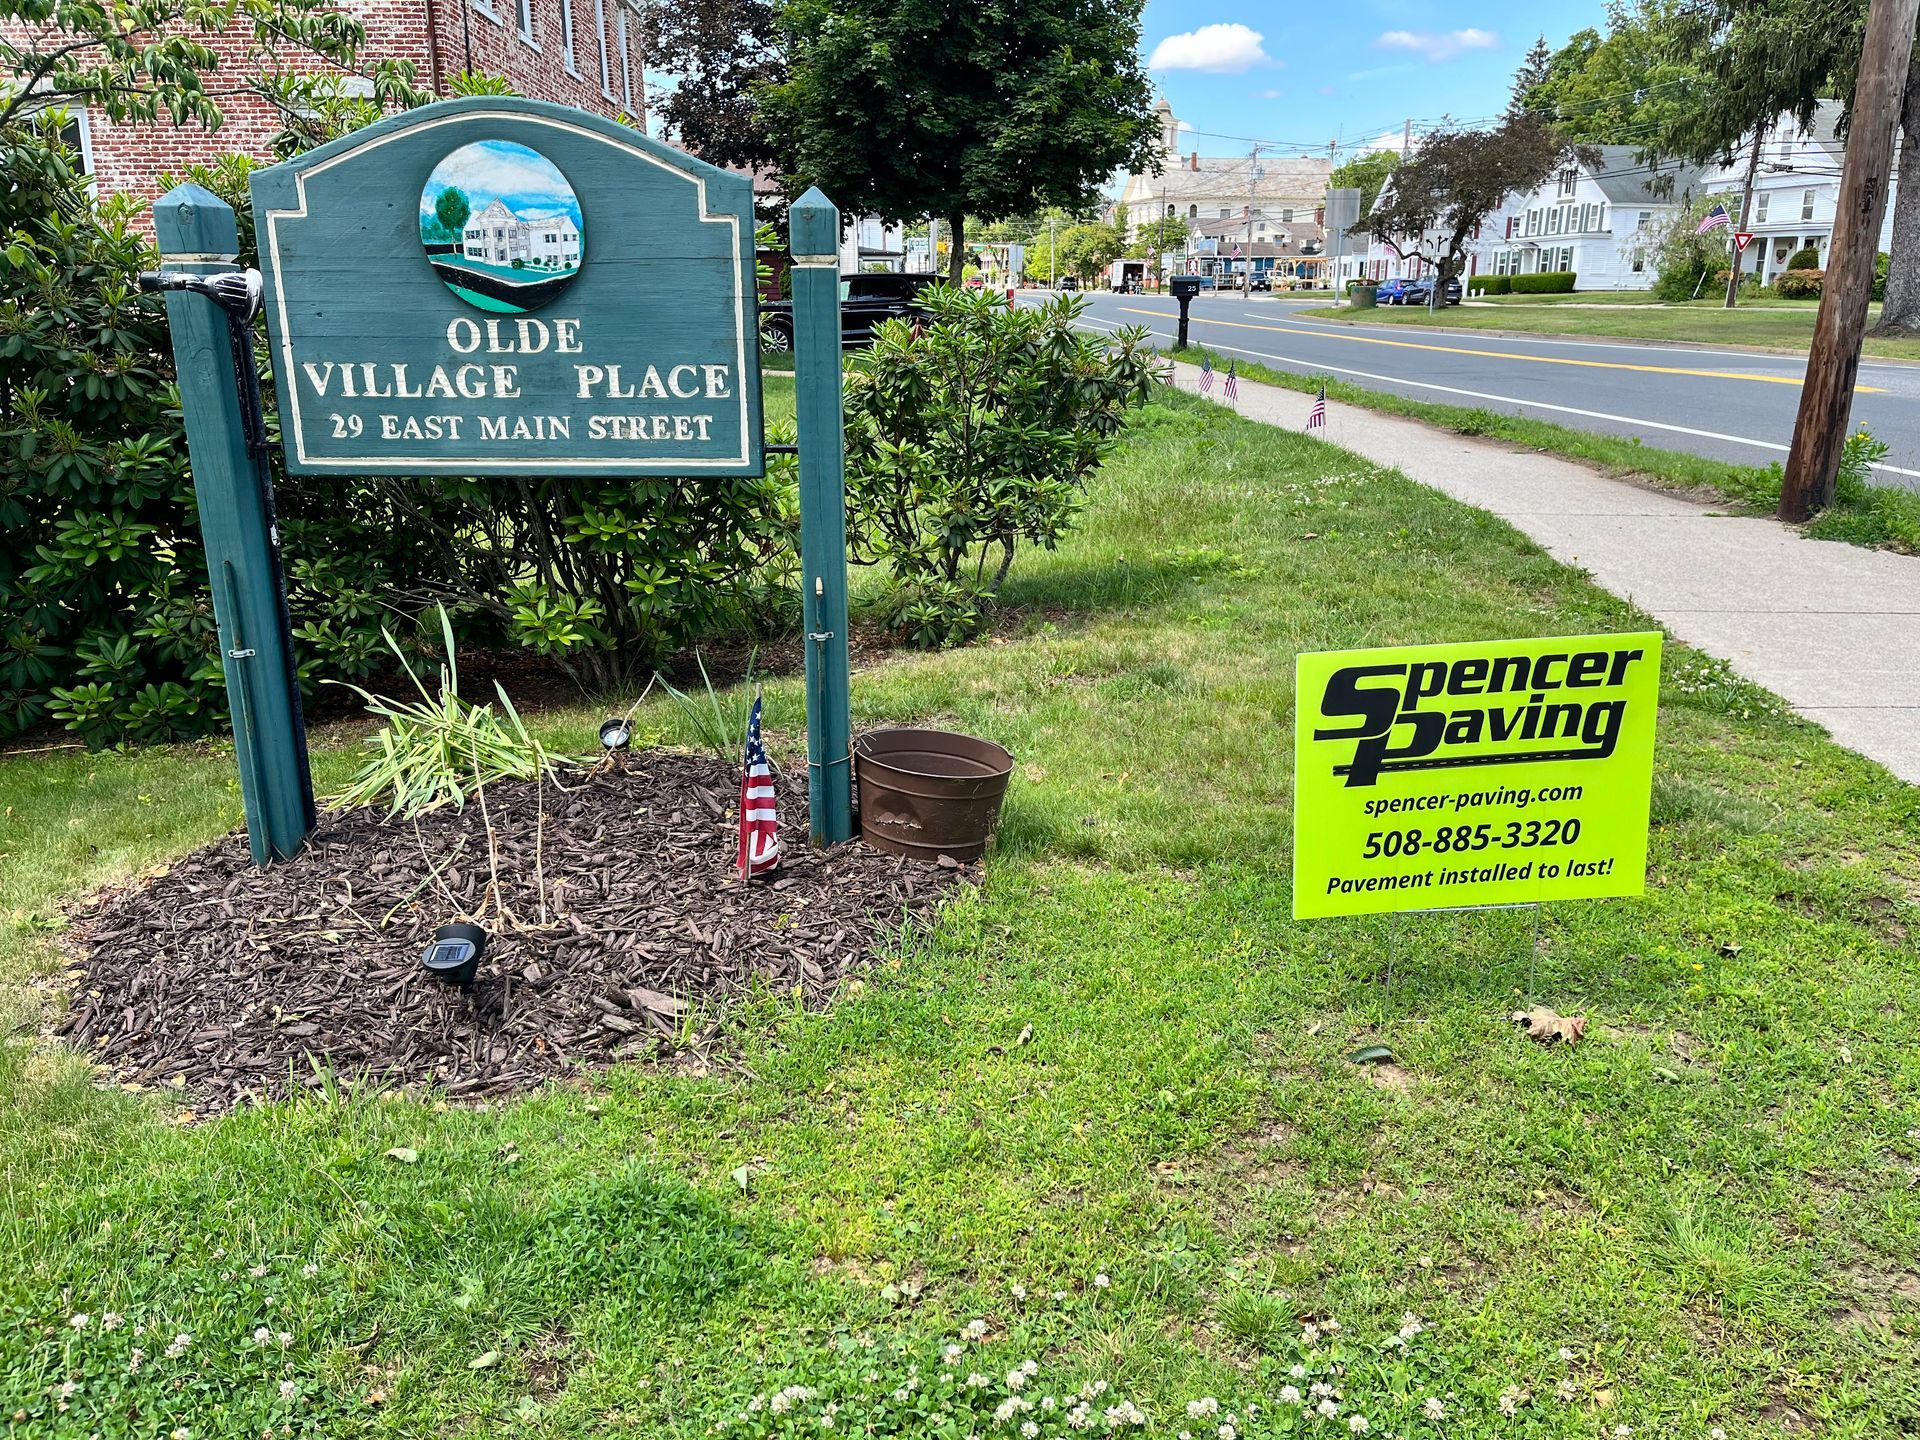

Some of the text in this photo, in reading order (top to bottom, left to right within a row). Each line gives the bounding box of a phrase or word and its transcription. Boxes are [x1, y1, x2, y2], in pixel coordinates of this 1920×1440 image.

[446, 317, 584, 354] OLDE
[302, 361, 731, 399] VILLAGE PLACE
[328, 412, 714, 441] 29 EAST MAIN STREET
[1313, 649, 1644, 741] Spencer
[1341, 694, 1628, 788] Paving
[1363, 785, 1583, 818] spencer-paving.com
[1363, 819, 1582, 859] 508-885-3320
[1326, 858, 1615, 895] Pavement installed to last!
